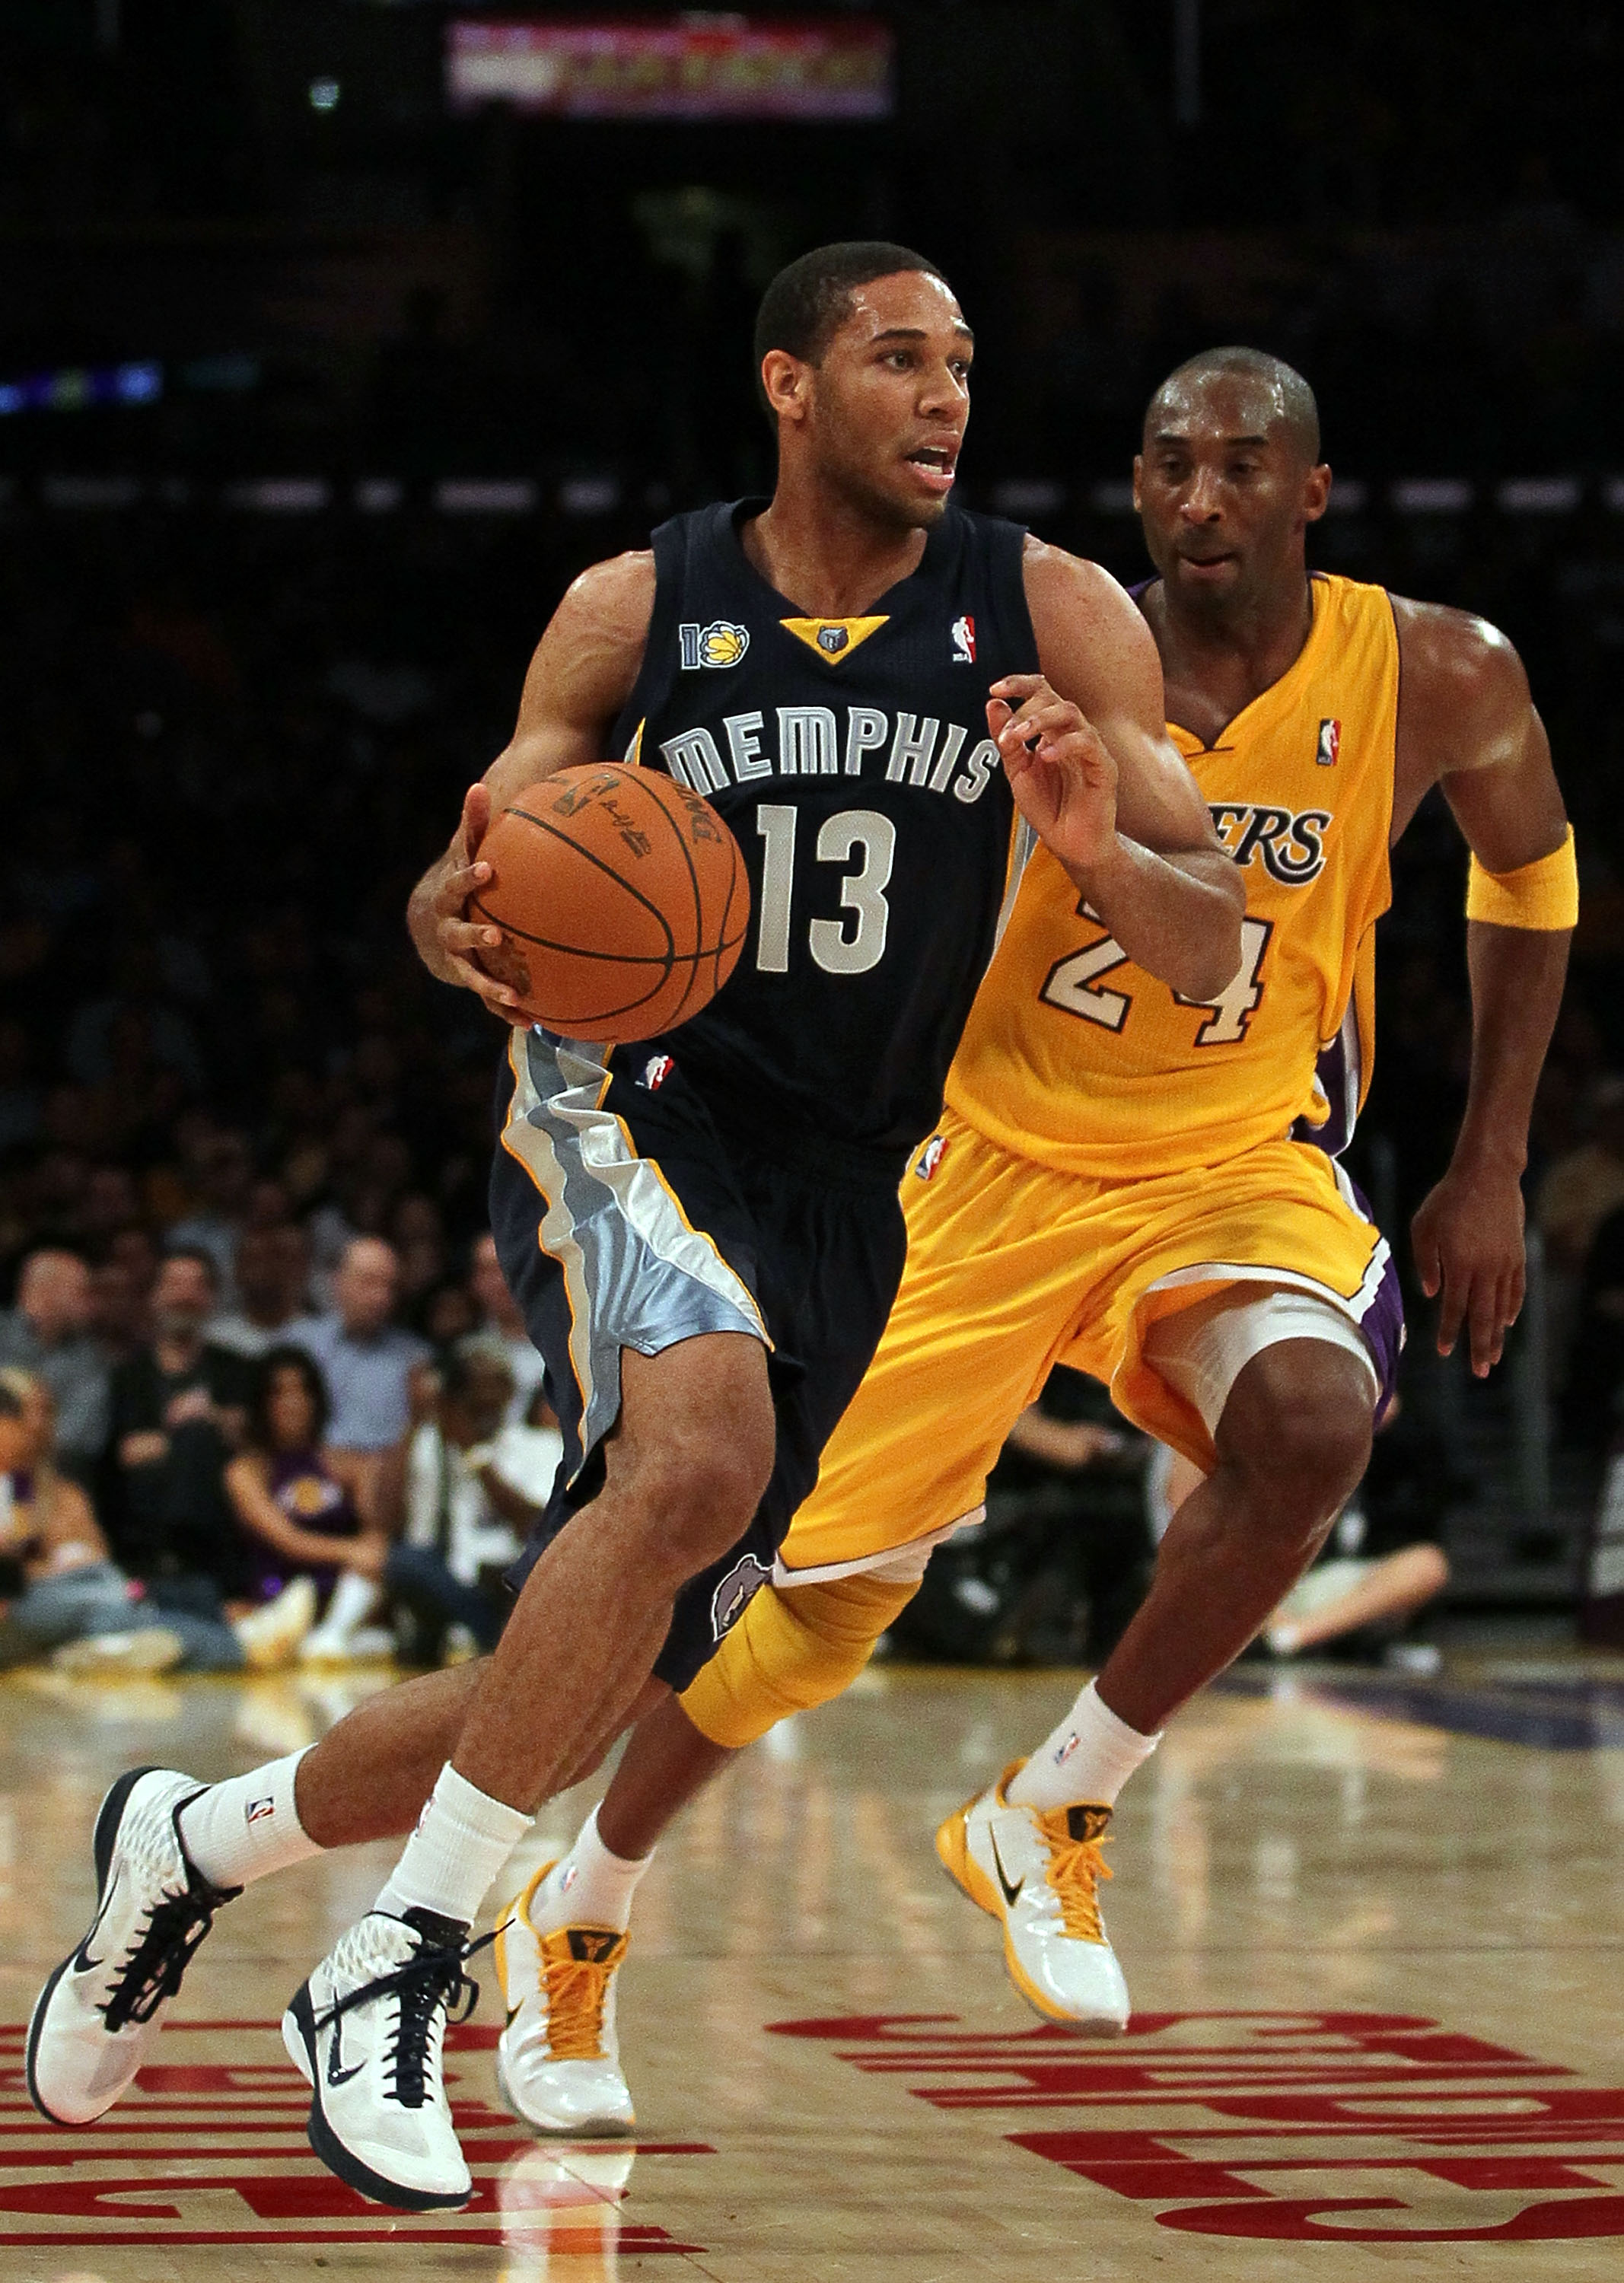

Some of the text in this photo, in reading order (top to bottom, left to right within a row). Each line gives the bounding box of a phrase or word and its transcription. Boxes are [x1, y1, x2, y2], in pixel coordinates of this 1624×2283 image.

[659, 705, 1001, 804] MEMPHIS
[756, 804, 897, 975] 13
[1207, 802, 1334, 887] ERS
[1037, 893, 1275, 1048] 24
